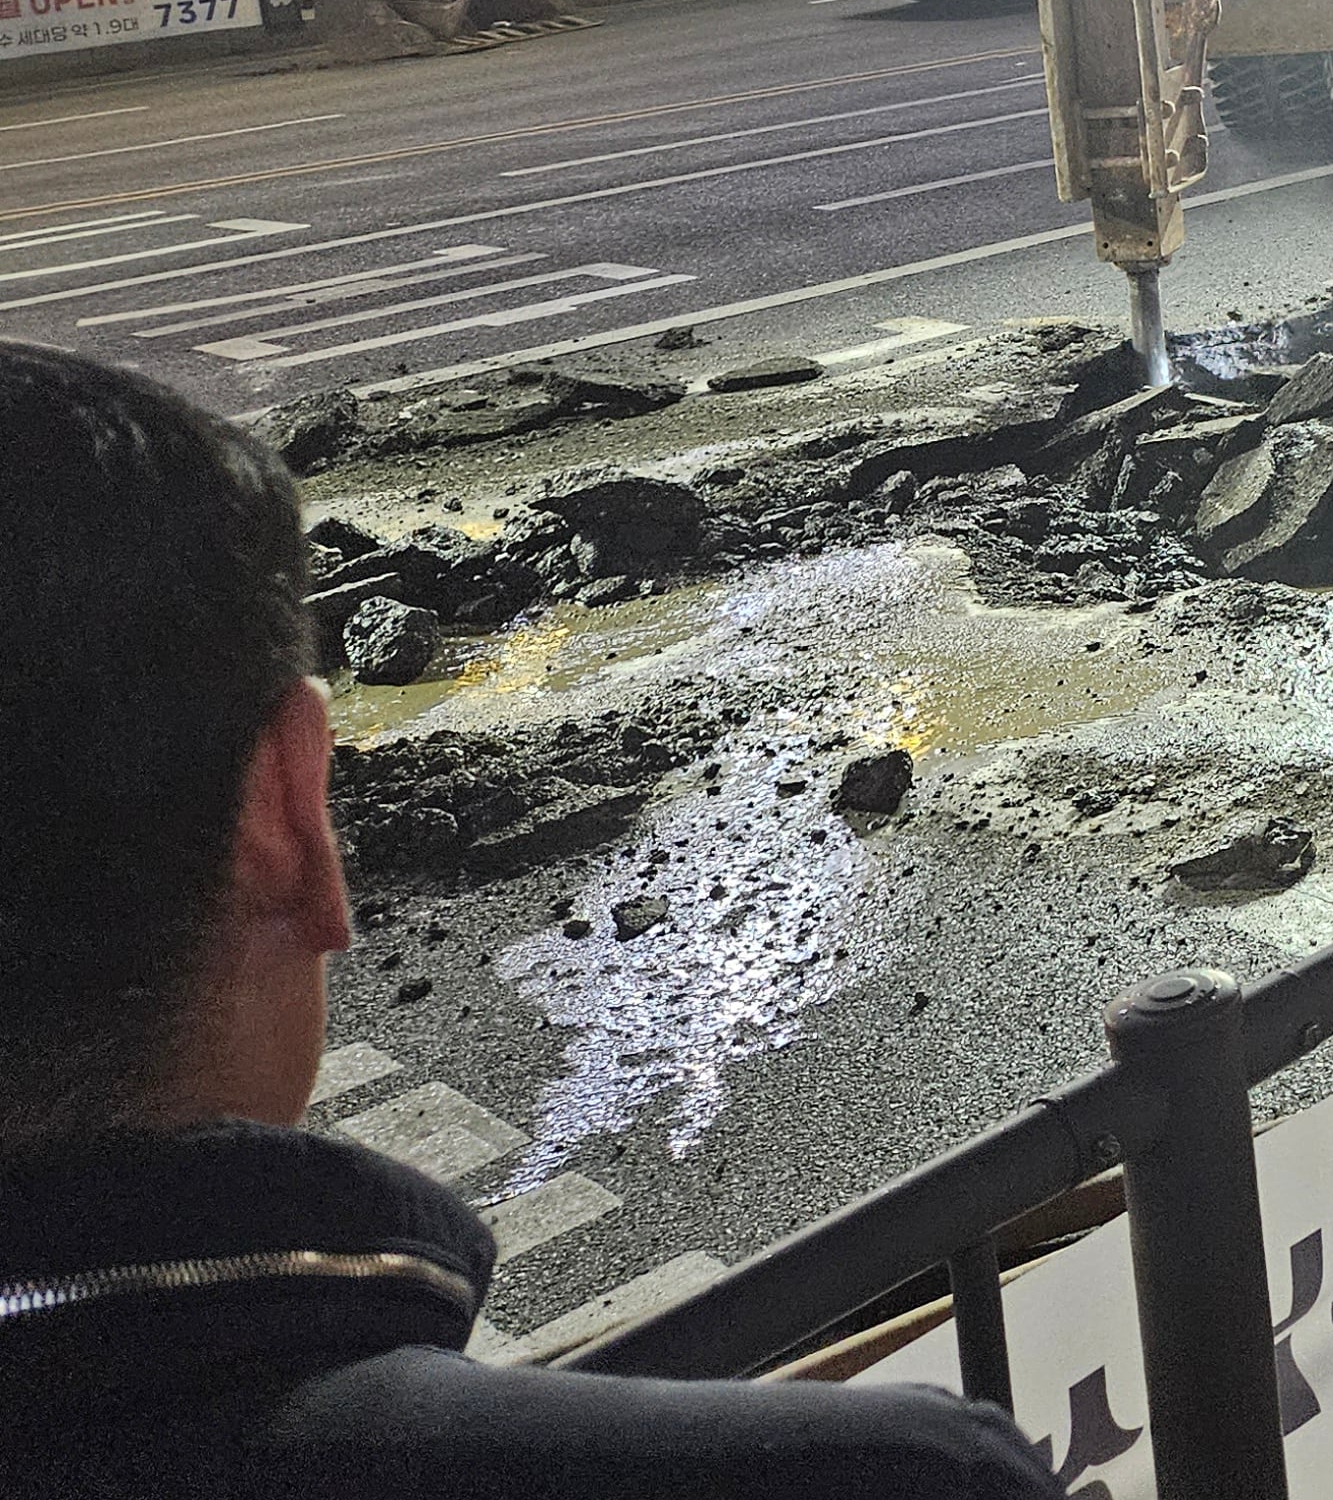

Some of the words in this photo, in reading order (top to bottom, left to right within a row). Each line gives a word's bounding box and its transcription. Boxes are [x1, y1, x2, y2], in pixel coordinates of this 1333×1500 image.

[17, 26, 68, 47] 세대당
[71, 22, 89, 39] 약
[94, 17, 140, 37] 1.9대
